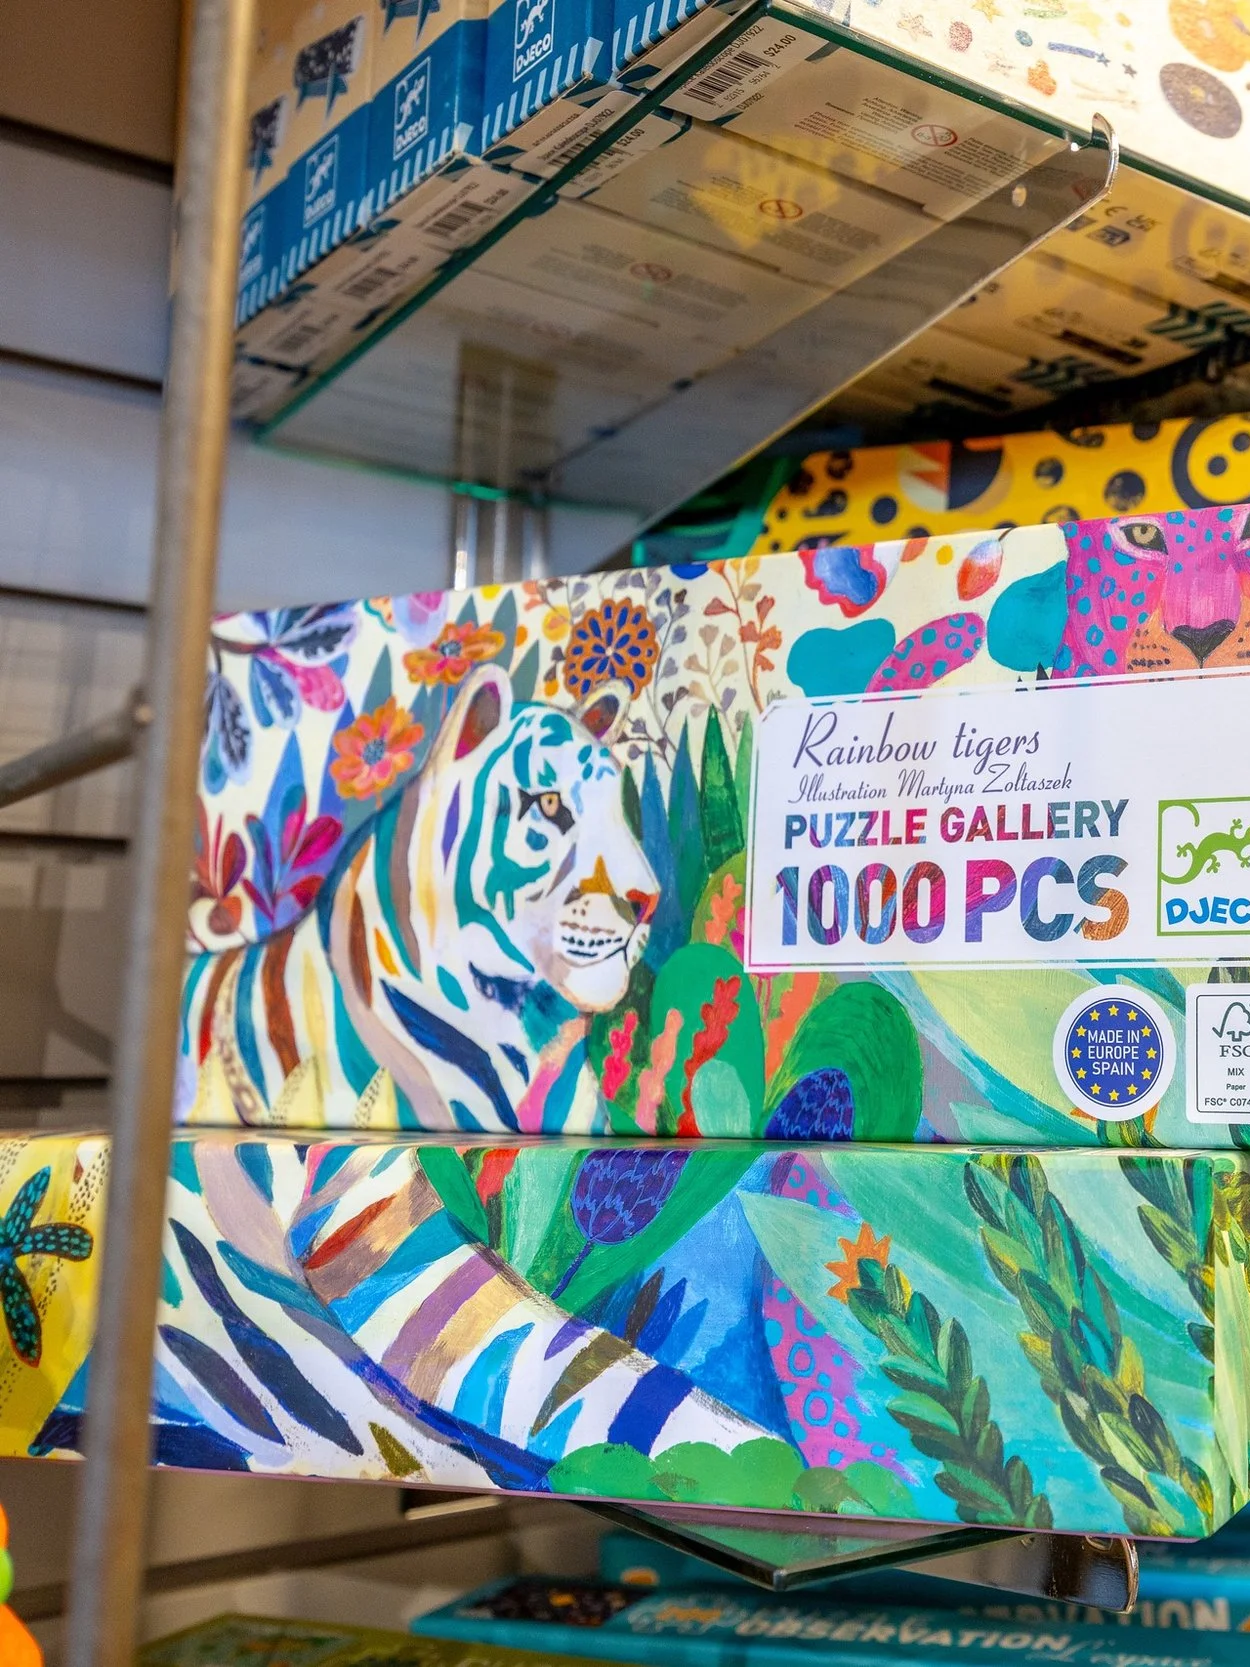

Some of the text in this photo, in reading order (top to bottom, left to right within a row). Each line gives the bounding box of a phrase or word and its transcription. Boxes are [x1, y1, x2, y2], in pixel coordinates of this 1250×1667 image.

[516, 34, 551, 74] DJECO
[763, 34, 797, 57] $24.00
[617, 128, 645, 147] $24.00
[793, 711, 1041, 776] Rainbow tigers
[787, 762, 1073, 804] Illustration Martyna Zoltaszek
[784, 798, 1130, 850] PUZZLE GALLERY
[775, 855, 1131, 946] 1000 PCS
[1088, 1030, 1141, 1043] MADE IN
[1088, 1046, 1140, 1060] EUROPE
[1092, 1061, 1136, 1076] SPAIN
[1227, 1067, 1245, 1077] MIX
[1226, 1083, 1247, 1092] Paper
